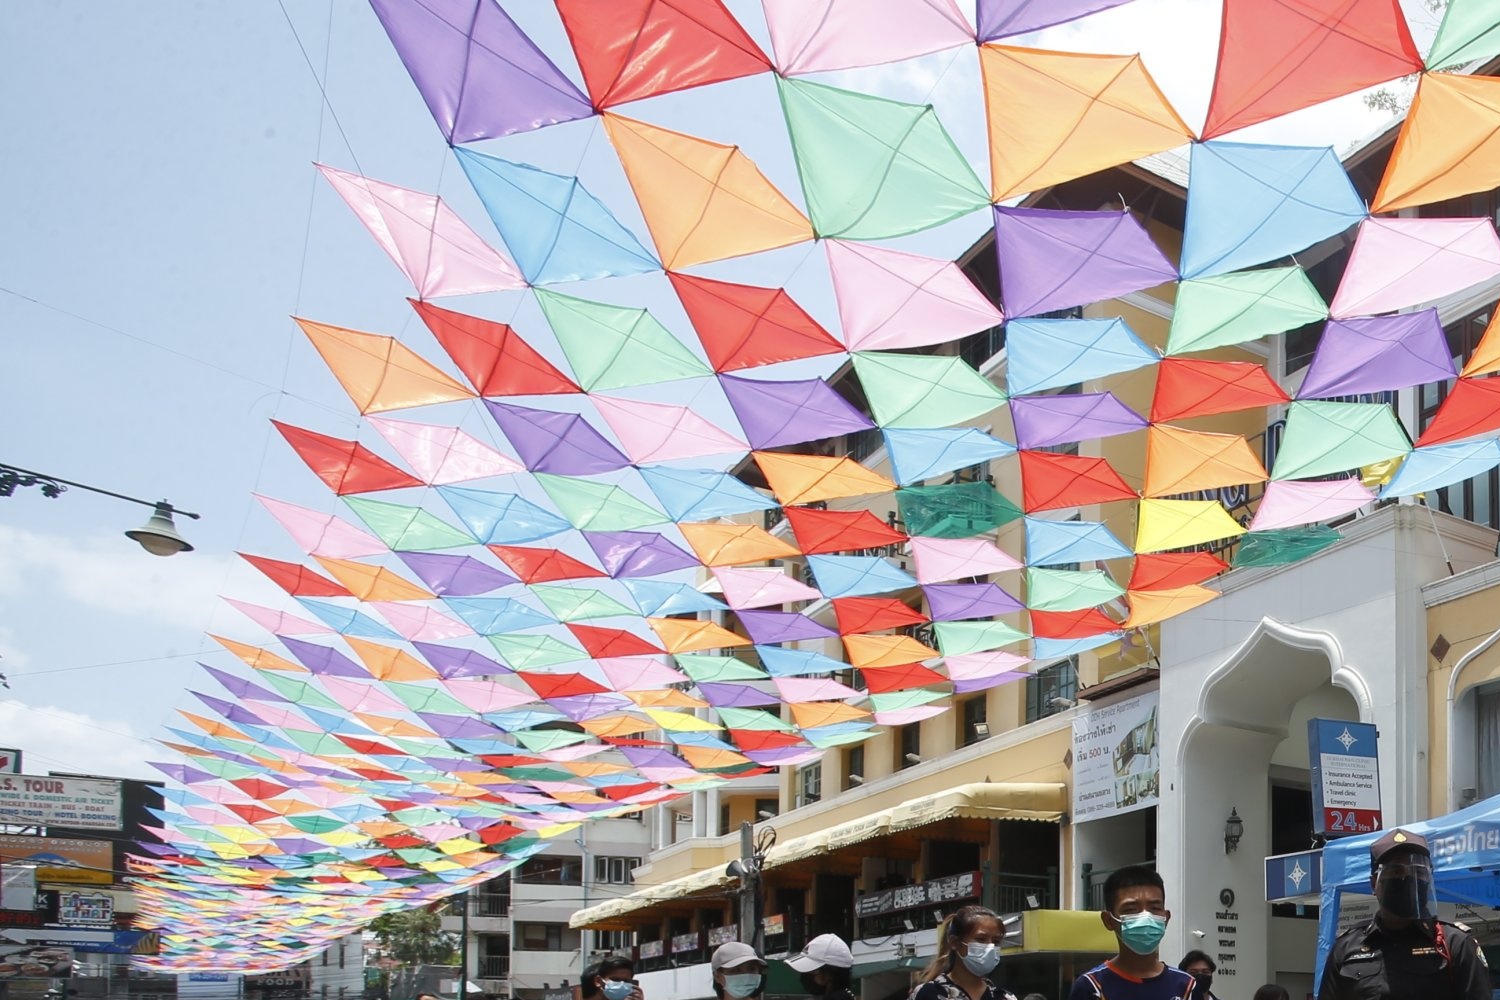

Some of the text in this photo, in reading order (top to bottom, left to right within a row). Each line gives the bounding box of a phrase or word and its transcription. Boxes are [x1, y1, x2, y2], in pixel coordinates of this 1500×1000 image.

[1089, 748, 1101, 759] 500
[24, 780, 65, 794] TOUR
[1330, 798, 1357, 807] Emergency
[1330, 810, 1357, 831] 24
[1433, 825, 1499, 864] กรุงไทย
